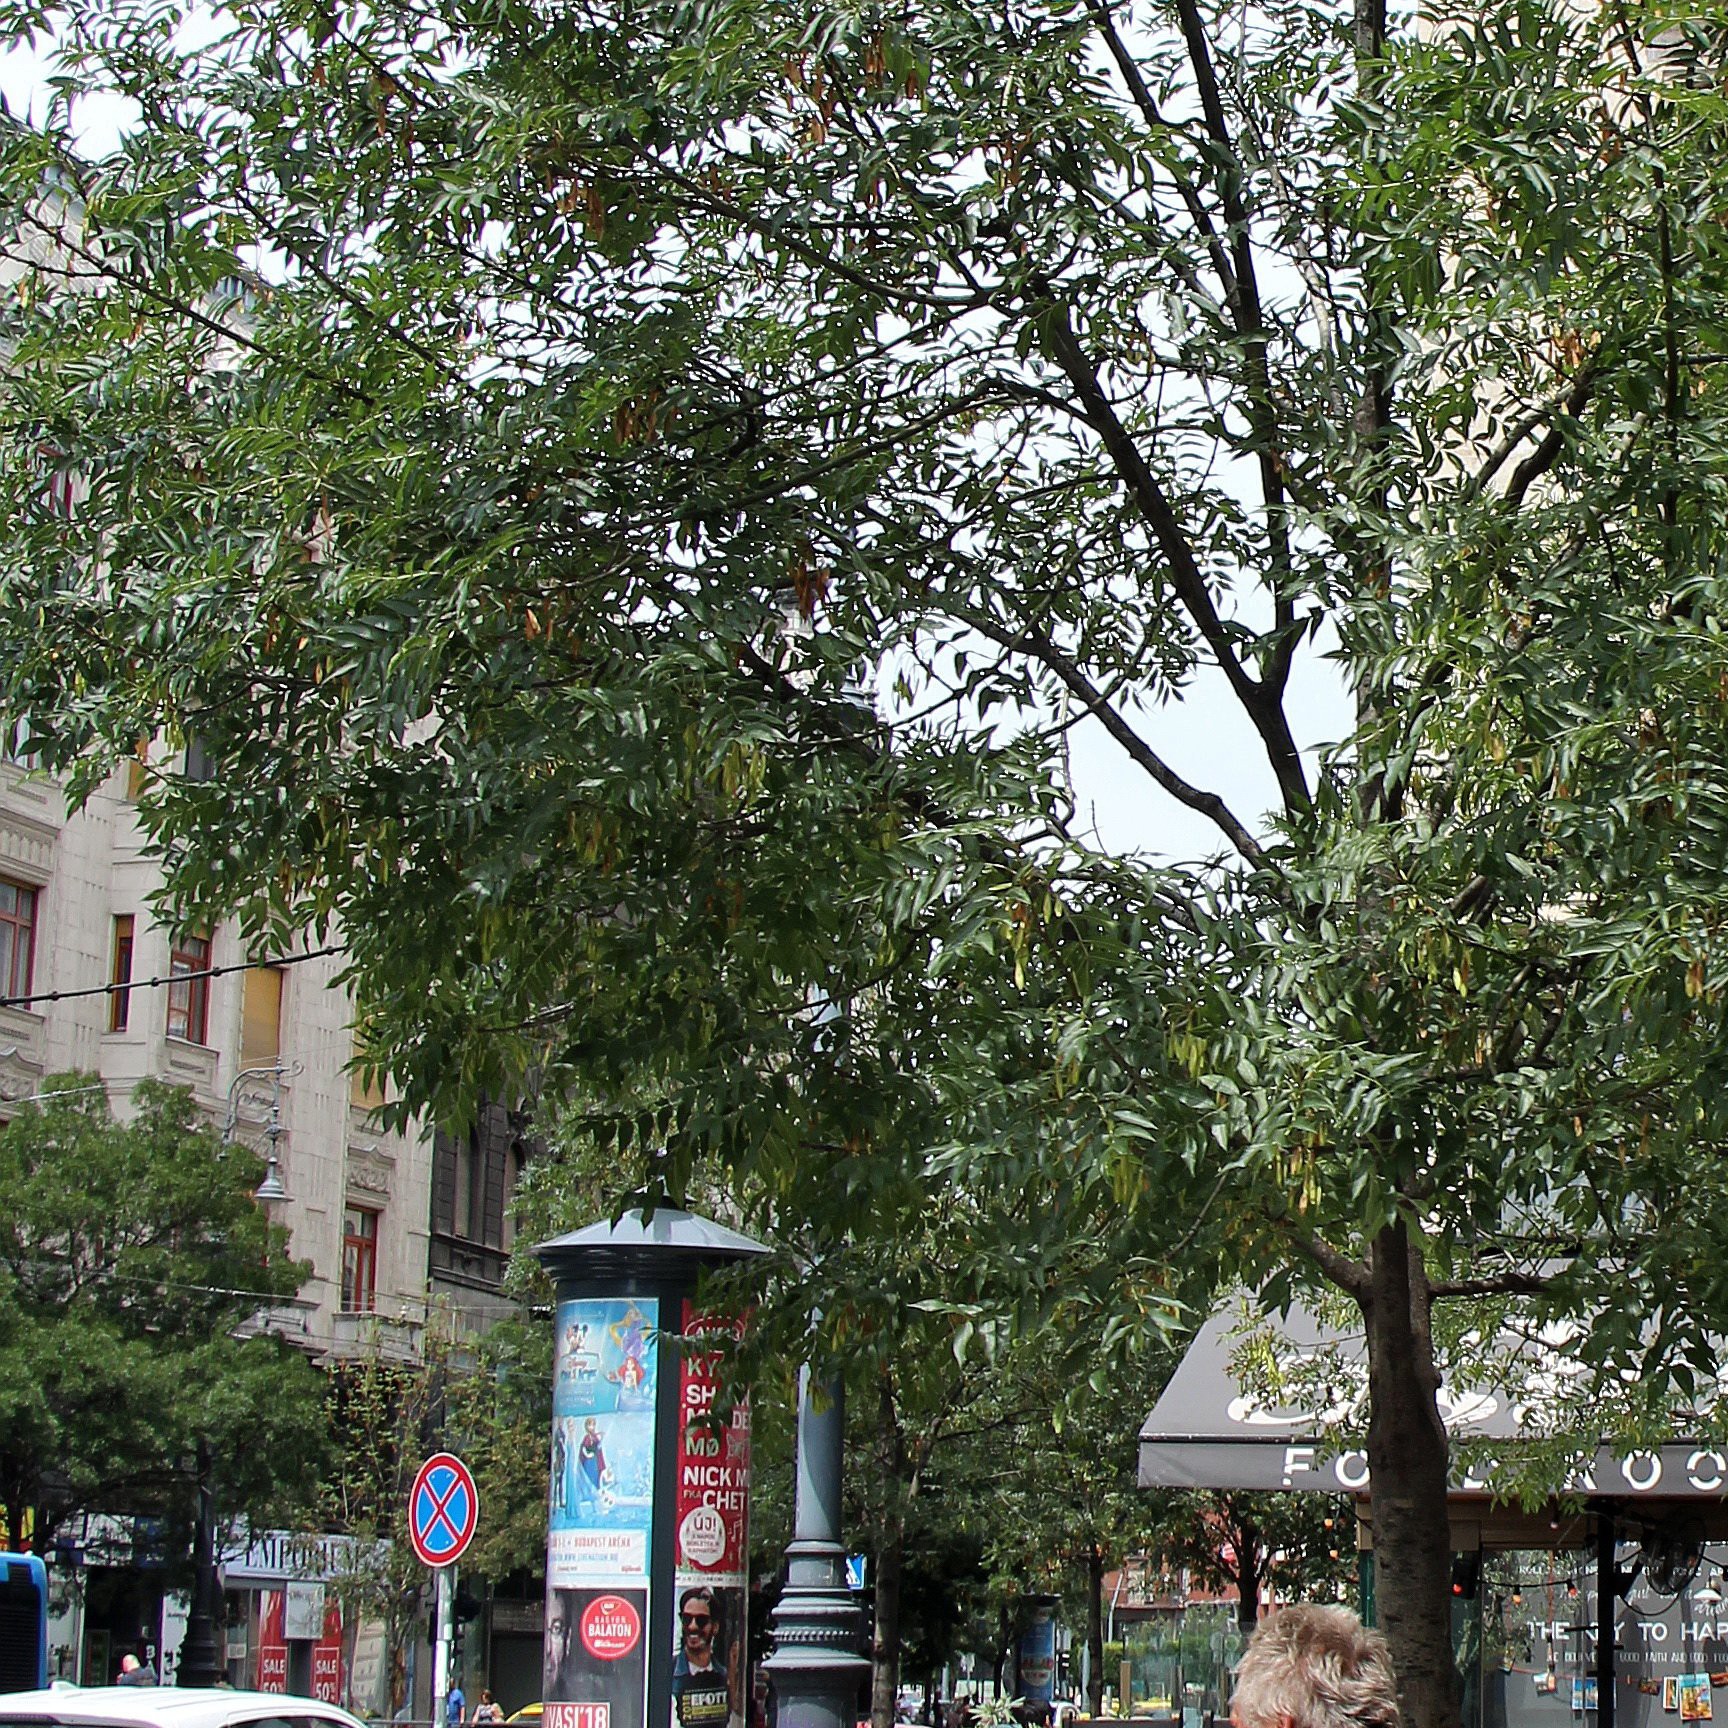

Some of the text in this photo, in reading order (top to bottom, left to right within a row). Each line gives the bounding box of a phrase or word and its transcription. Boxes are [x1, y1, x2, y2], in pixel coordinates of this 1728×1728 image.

[683, 1465, 732, 1486] NICK
[703, 1489, 746, 1511] CHET
[588, 1623, 632, 1637] BALATON
[1526, 1620, 1571, 1641] THE
[1637, 1621, 1669, 1642] TO
[263, 1658, 286, 1674] SALE
[315, 1658, 338, 1674] SALE
